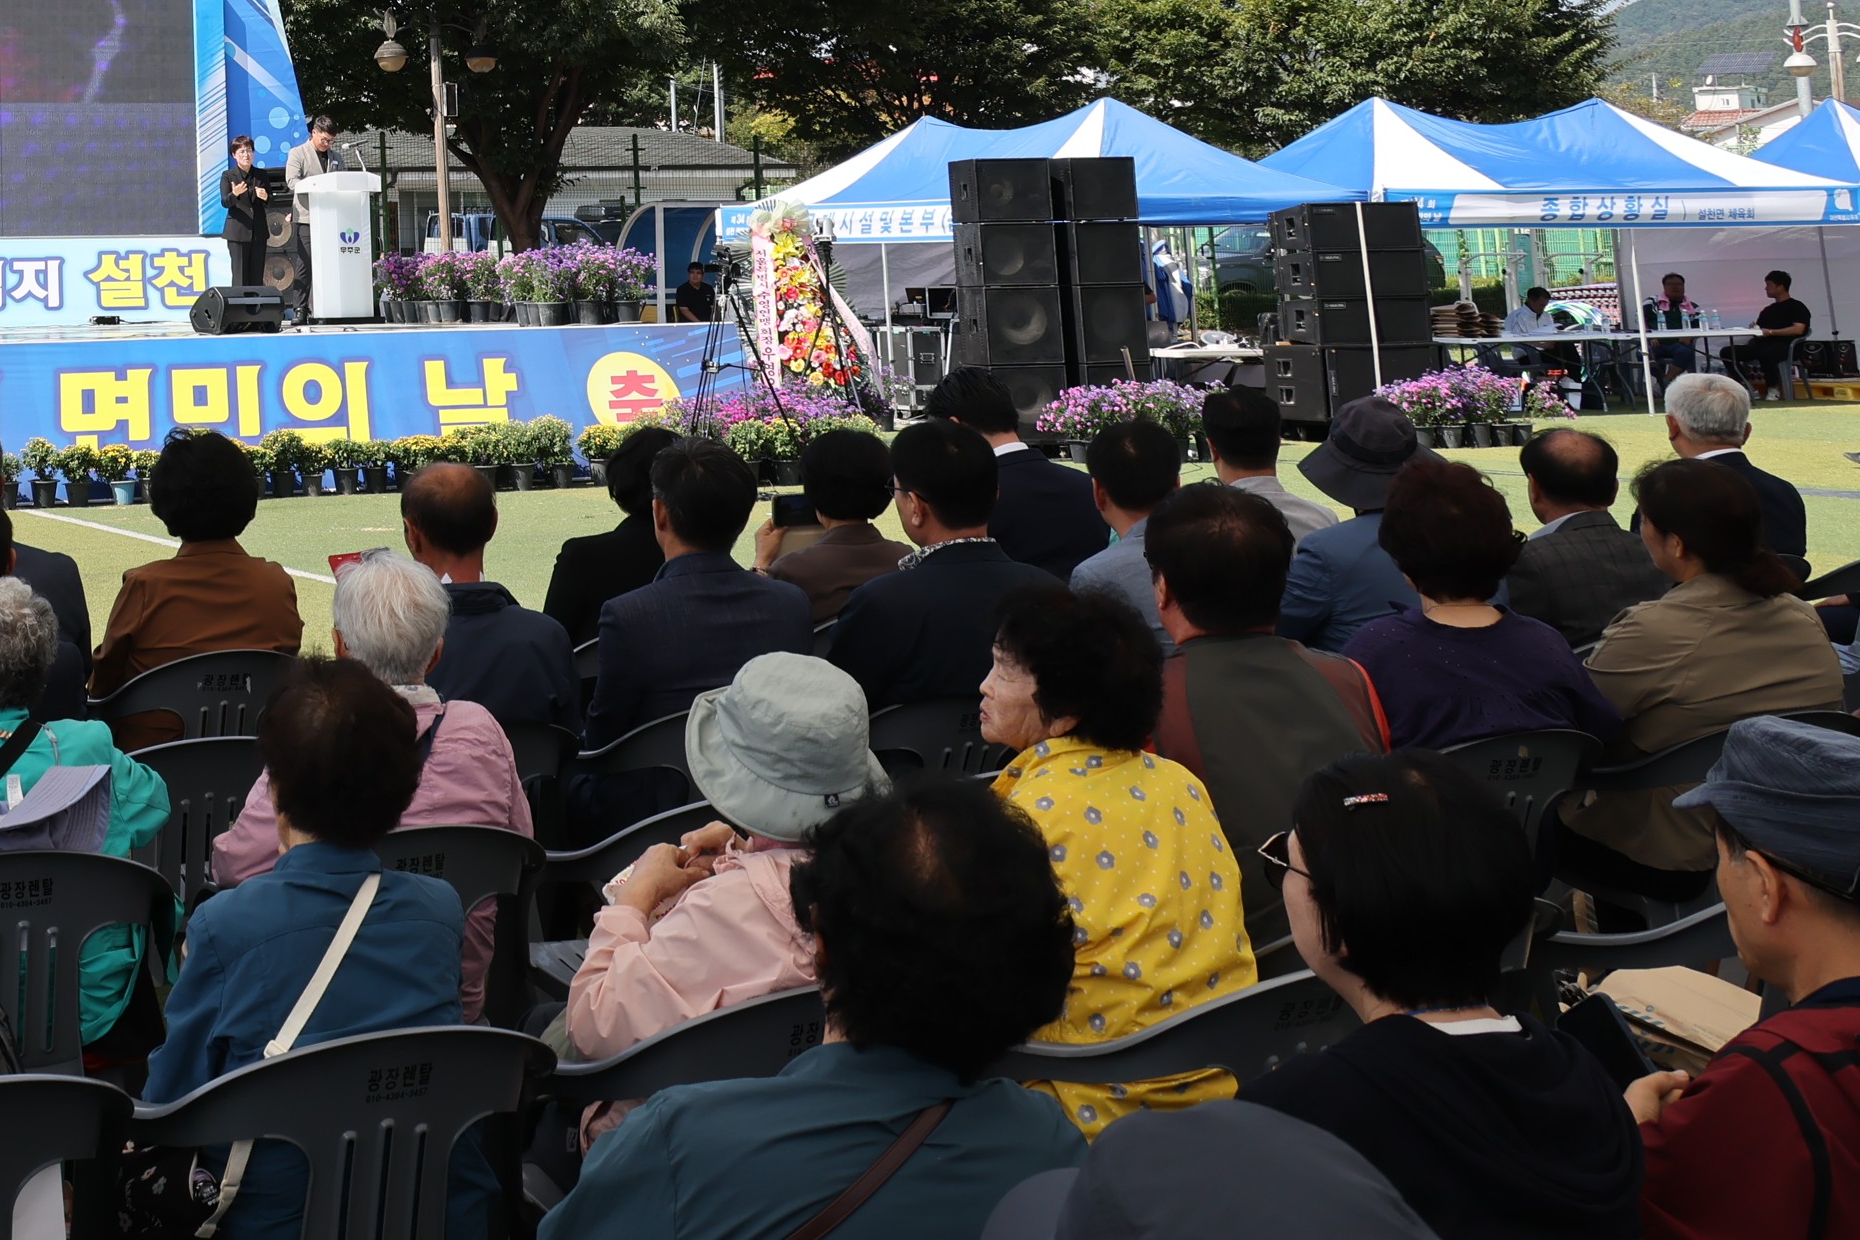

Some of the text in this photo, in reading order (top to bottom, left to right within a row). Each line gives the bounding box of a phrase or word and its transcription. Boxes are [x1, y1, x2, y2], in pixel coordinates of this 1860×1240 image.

[1540, 195, 1669, 222] 종합상황실
[88, 251, 208, 309] 설천
[424, 357, 518, 437] 날
[0, 877, 54, 900] 광장렌탈
[367, 1060, 433, 1092] 광장렌탈
